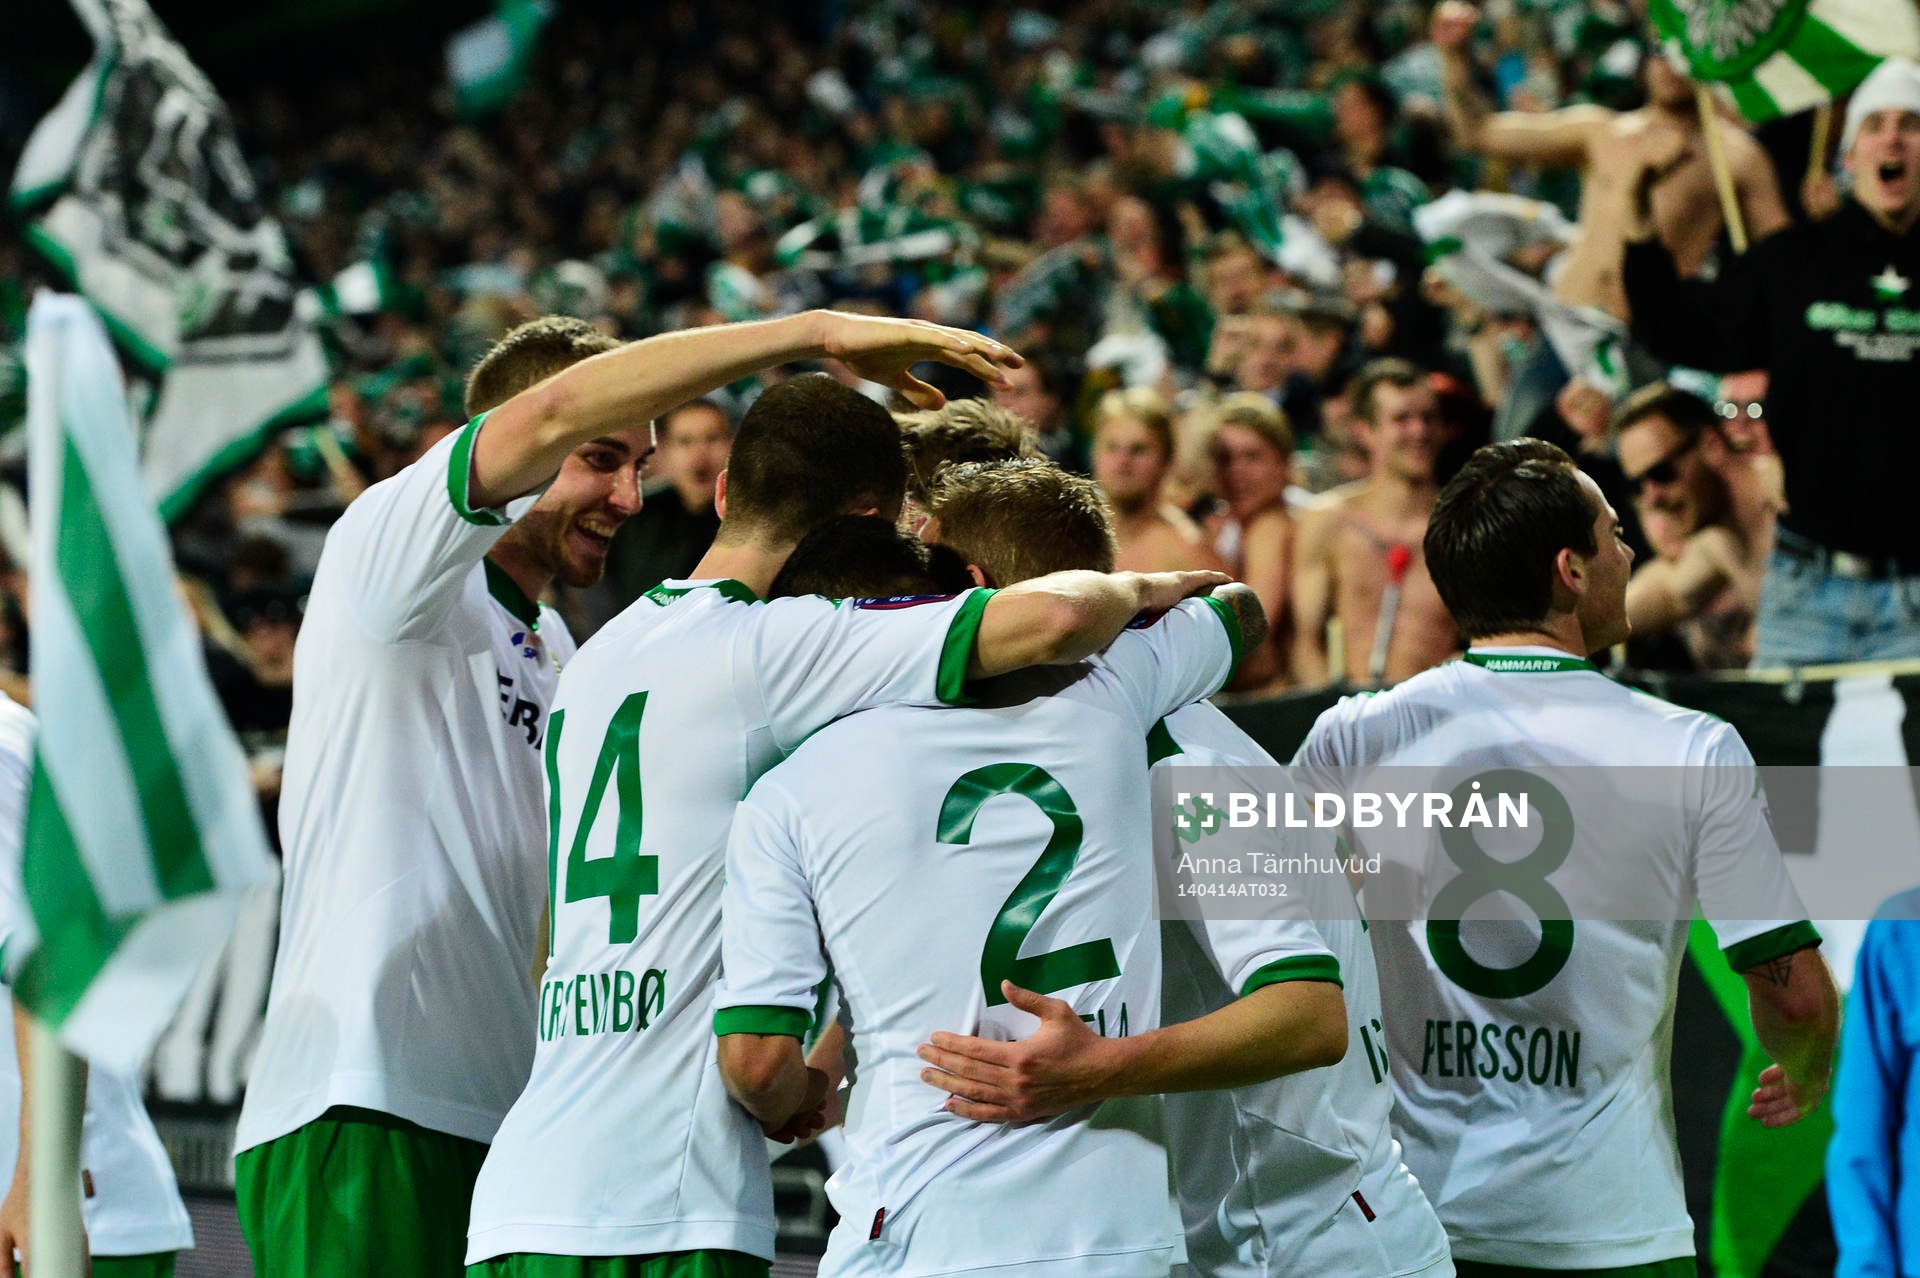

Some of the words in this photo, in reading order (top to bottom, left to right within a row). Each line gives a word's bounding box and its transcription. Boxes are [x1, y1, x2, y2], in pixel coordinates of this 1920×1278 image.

[1484, 659, 1561, 672] HAMMARBY
[545, 690, 659, 957] 14
[936, 762, 1121, 1007] 2
[1426, 769, 1575, 1000] 8
[1421, 1018, 1581, 1088] PERSSON
